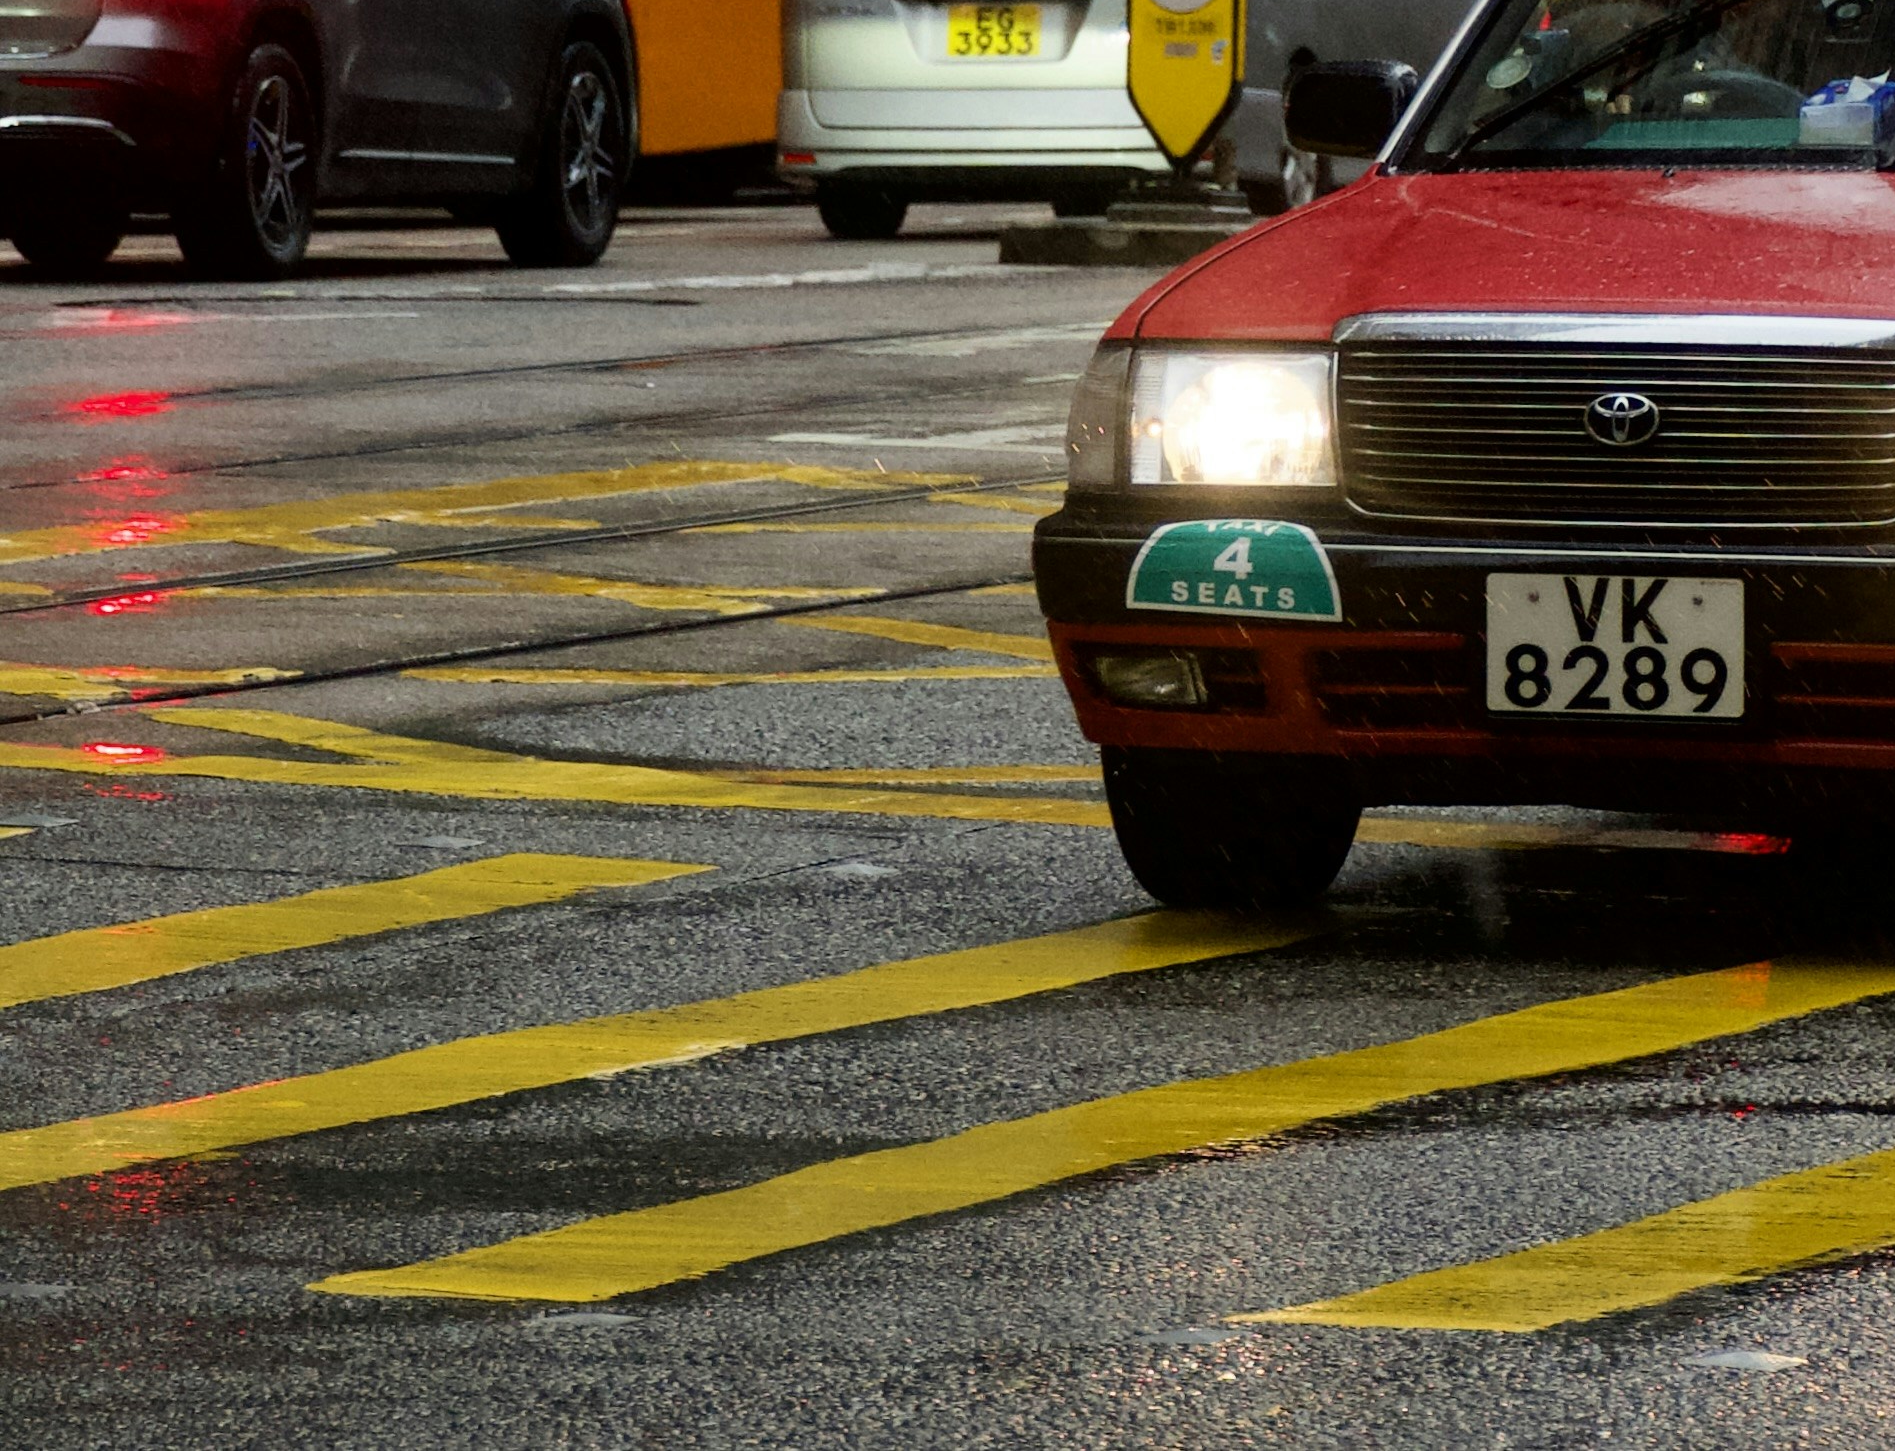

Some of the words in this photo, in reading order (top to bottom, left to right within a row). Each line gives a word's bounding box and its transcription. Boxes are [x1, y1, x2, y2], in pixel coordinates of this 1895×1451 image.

[955, 30, 1034, 56] 3933
[1212, 535, 1254, 581] 4
[1170, 579, 1296, 610] SEATS
[1562, 575, 1670, 646] VK
[1504, 643, 1729, 714] 8289
